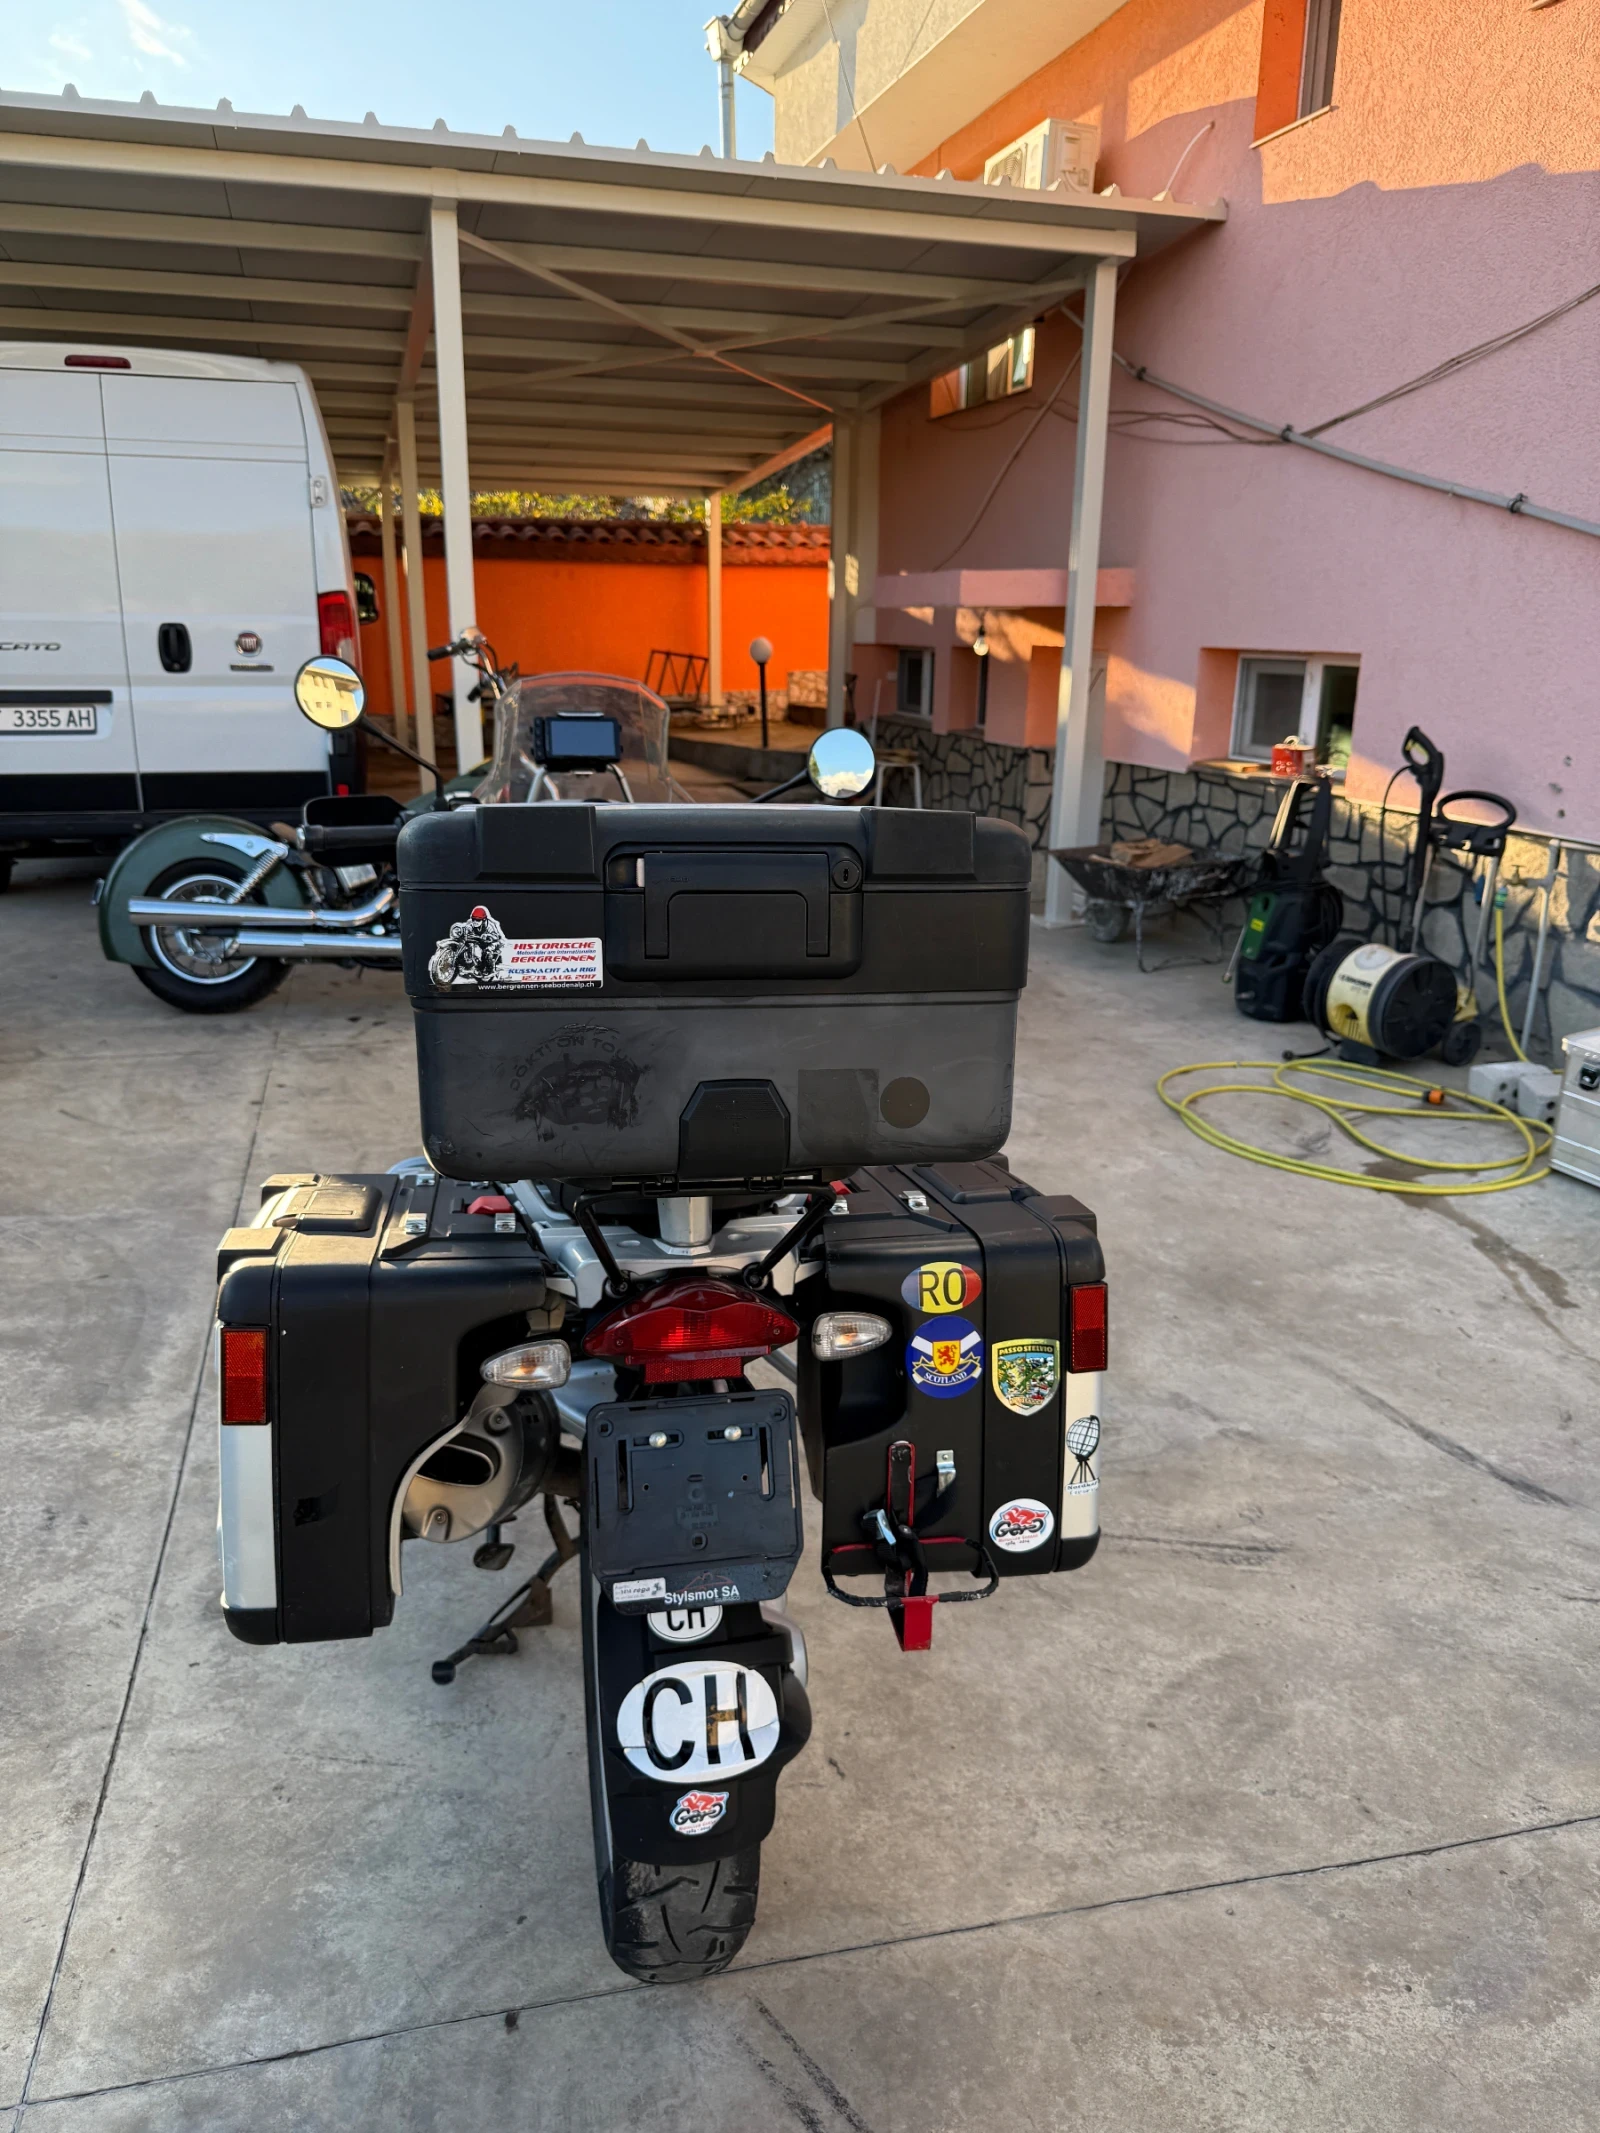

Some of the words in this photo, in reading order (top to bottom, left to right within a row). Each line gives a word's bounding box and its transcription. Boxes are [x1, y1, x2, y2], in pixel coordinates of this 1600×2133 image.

[13, 709, 62, 728] 3355
[66, 709, 91, 728] AH
[512, 941, 597, 950] HISTORISCHE
[510, 955, 597, 964] BERGRENNEN
[918, 1267, 968, 1308] RO
[998, 1346, 1023, 1356] PASSO
[923, 1371, 968, 1385] SCOTLAND
[664, 1587, 719, 1605] Stylsmot
[721, 1584, 740, 1597] SA
[642, 1670, 757, 1772] CH
